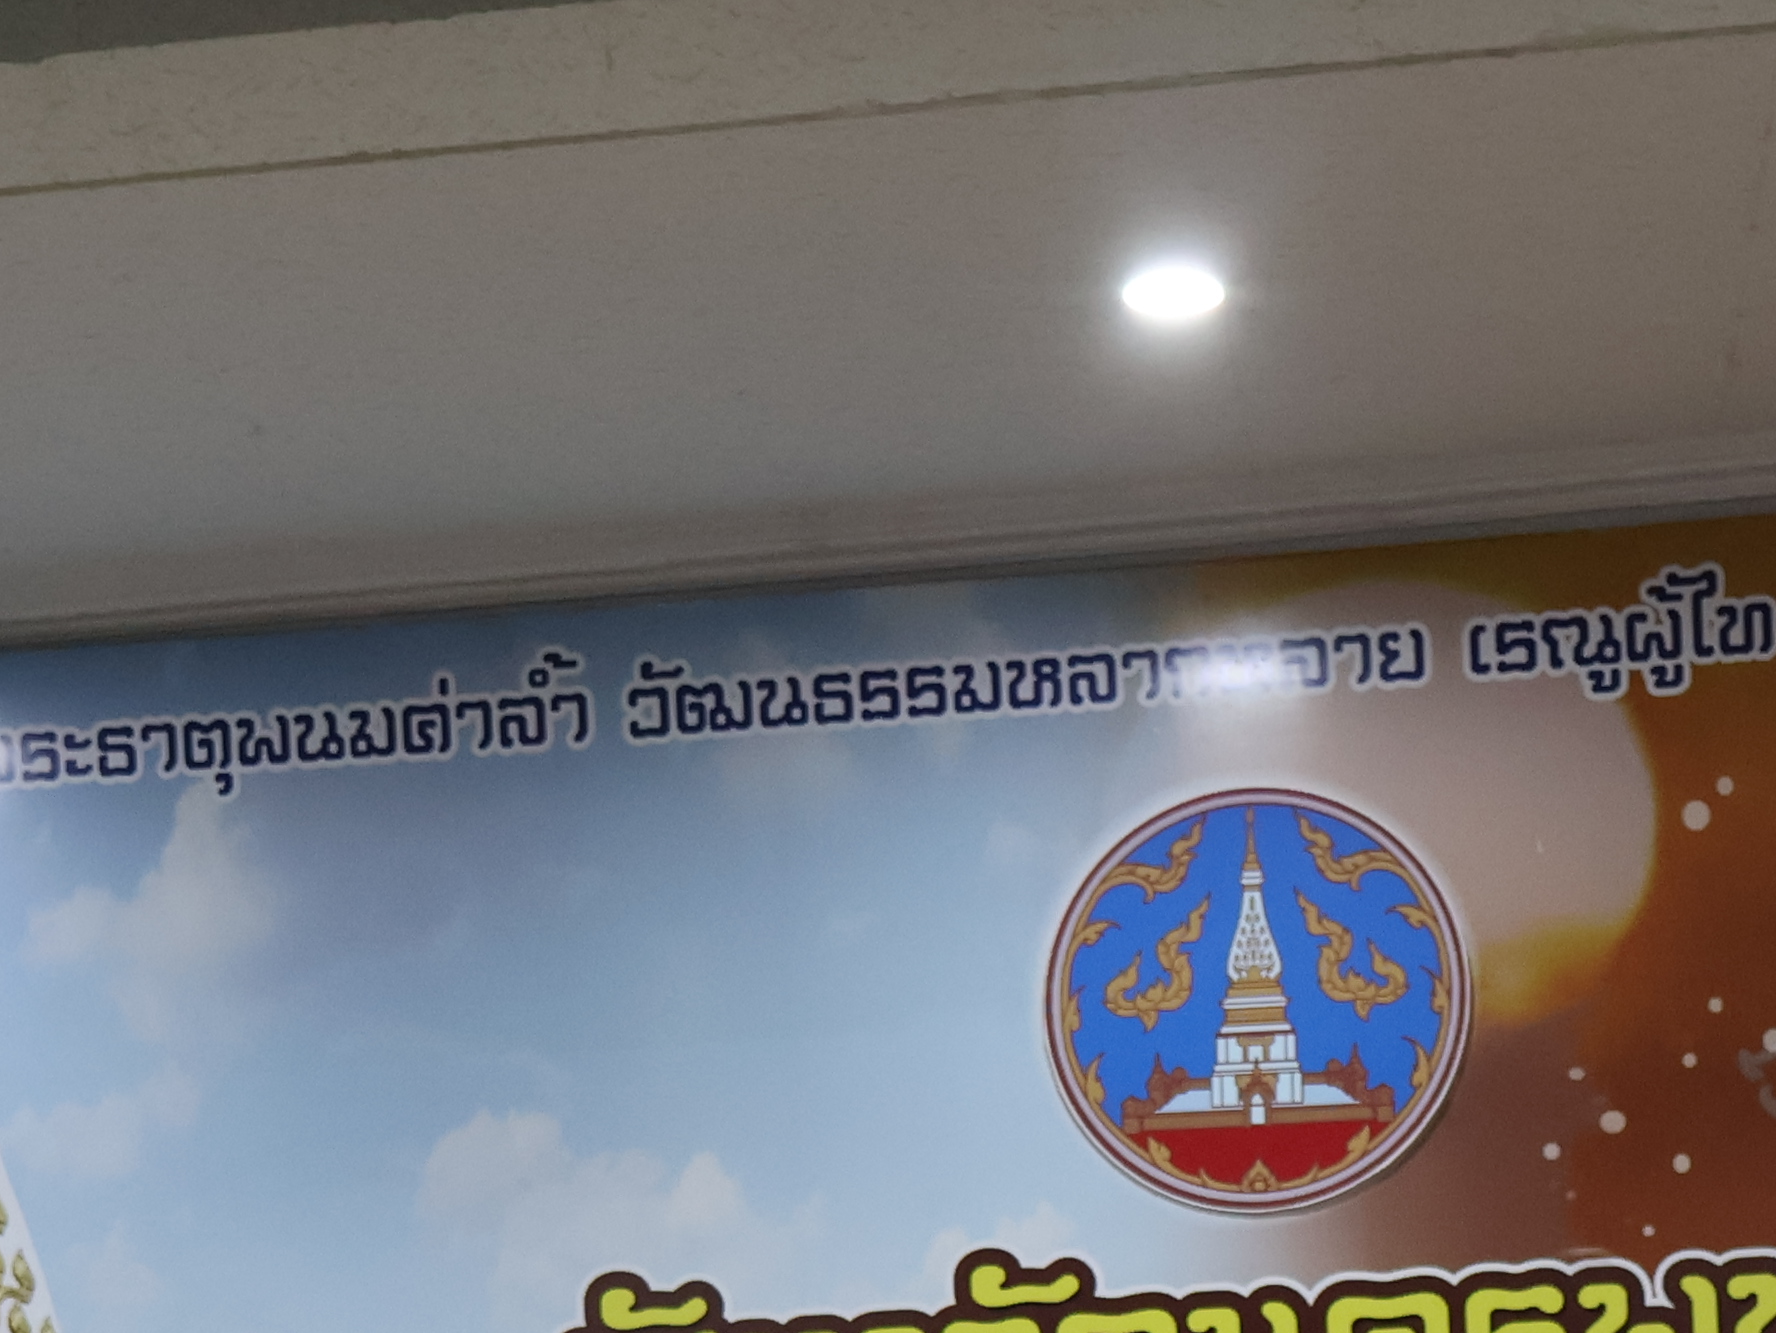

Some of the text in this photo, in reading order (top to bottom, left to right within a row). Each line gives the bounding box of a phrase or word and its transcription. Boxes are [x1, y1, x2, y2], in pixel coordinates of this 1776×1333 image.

[626, 627, 1425, 740] วัฒนธรรมหลากลาย
[1469, 570, 1776, 694] เรณูผู้ไท
